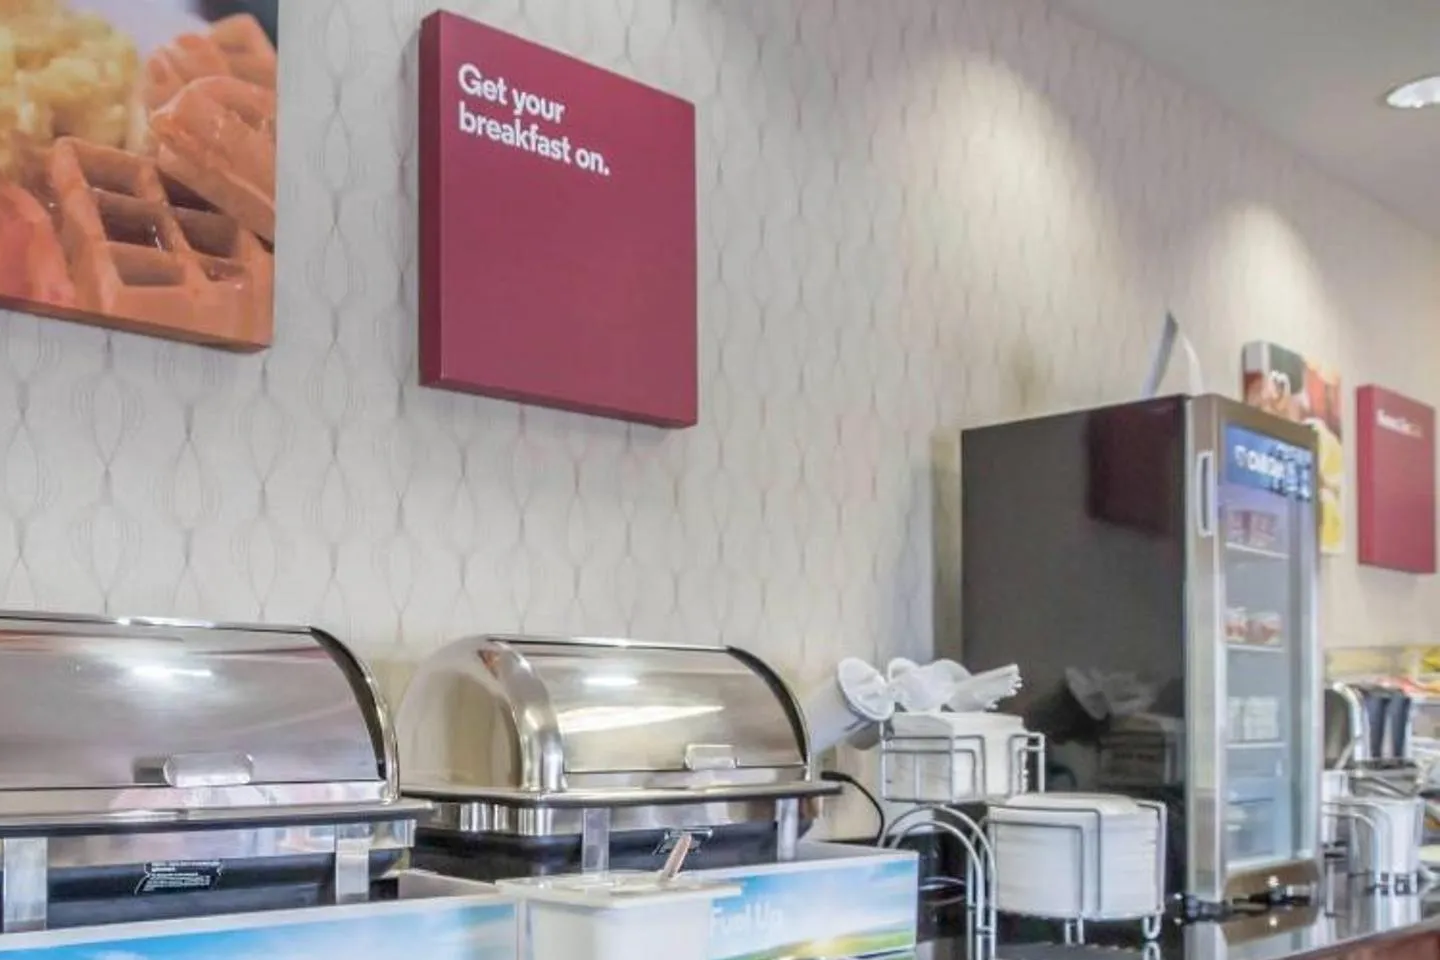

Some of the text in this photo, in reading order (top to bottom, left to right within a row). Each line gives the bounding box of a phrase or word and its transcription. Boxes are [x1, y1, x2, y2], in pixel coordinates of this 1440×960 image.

[458, 63, 566, 125] Get your
[458, 100, 611, 176] breakfast on.
[709, 900, 784, 938] Fuel Up
